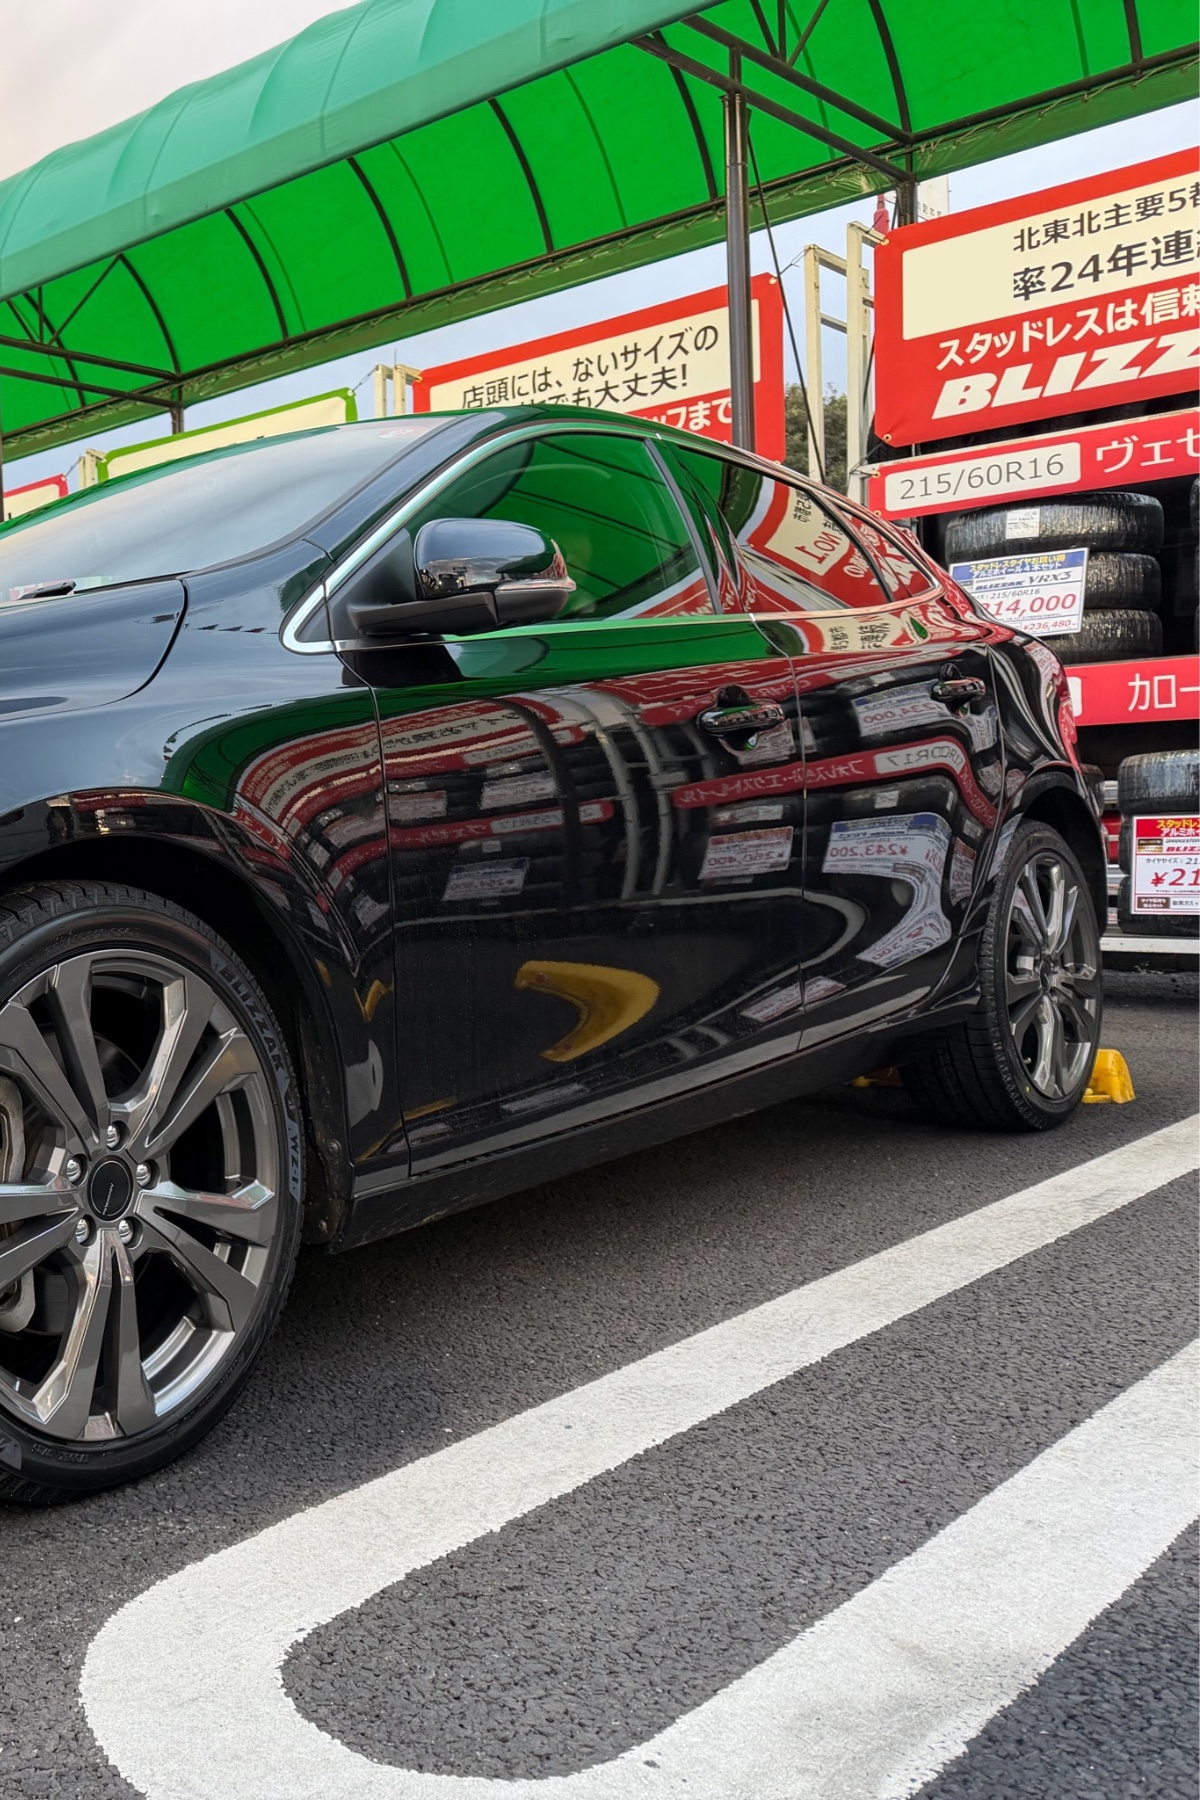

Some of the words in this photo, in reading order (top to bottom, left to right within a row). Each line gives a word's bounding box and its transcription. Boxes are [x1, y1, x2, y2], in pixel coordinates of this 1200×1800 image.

[1013, 229, 1200, 301] 率24年連
[931, 328, 1200, 420] BLIZZ
[900, 453, 1064, 500] 215/60R16
[1028, 571, 1072, 585] VRX3
[1185, 857, 1200, 865] 21
[217, 965, 285, 1072] BLIZZAK
